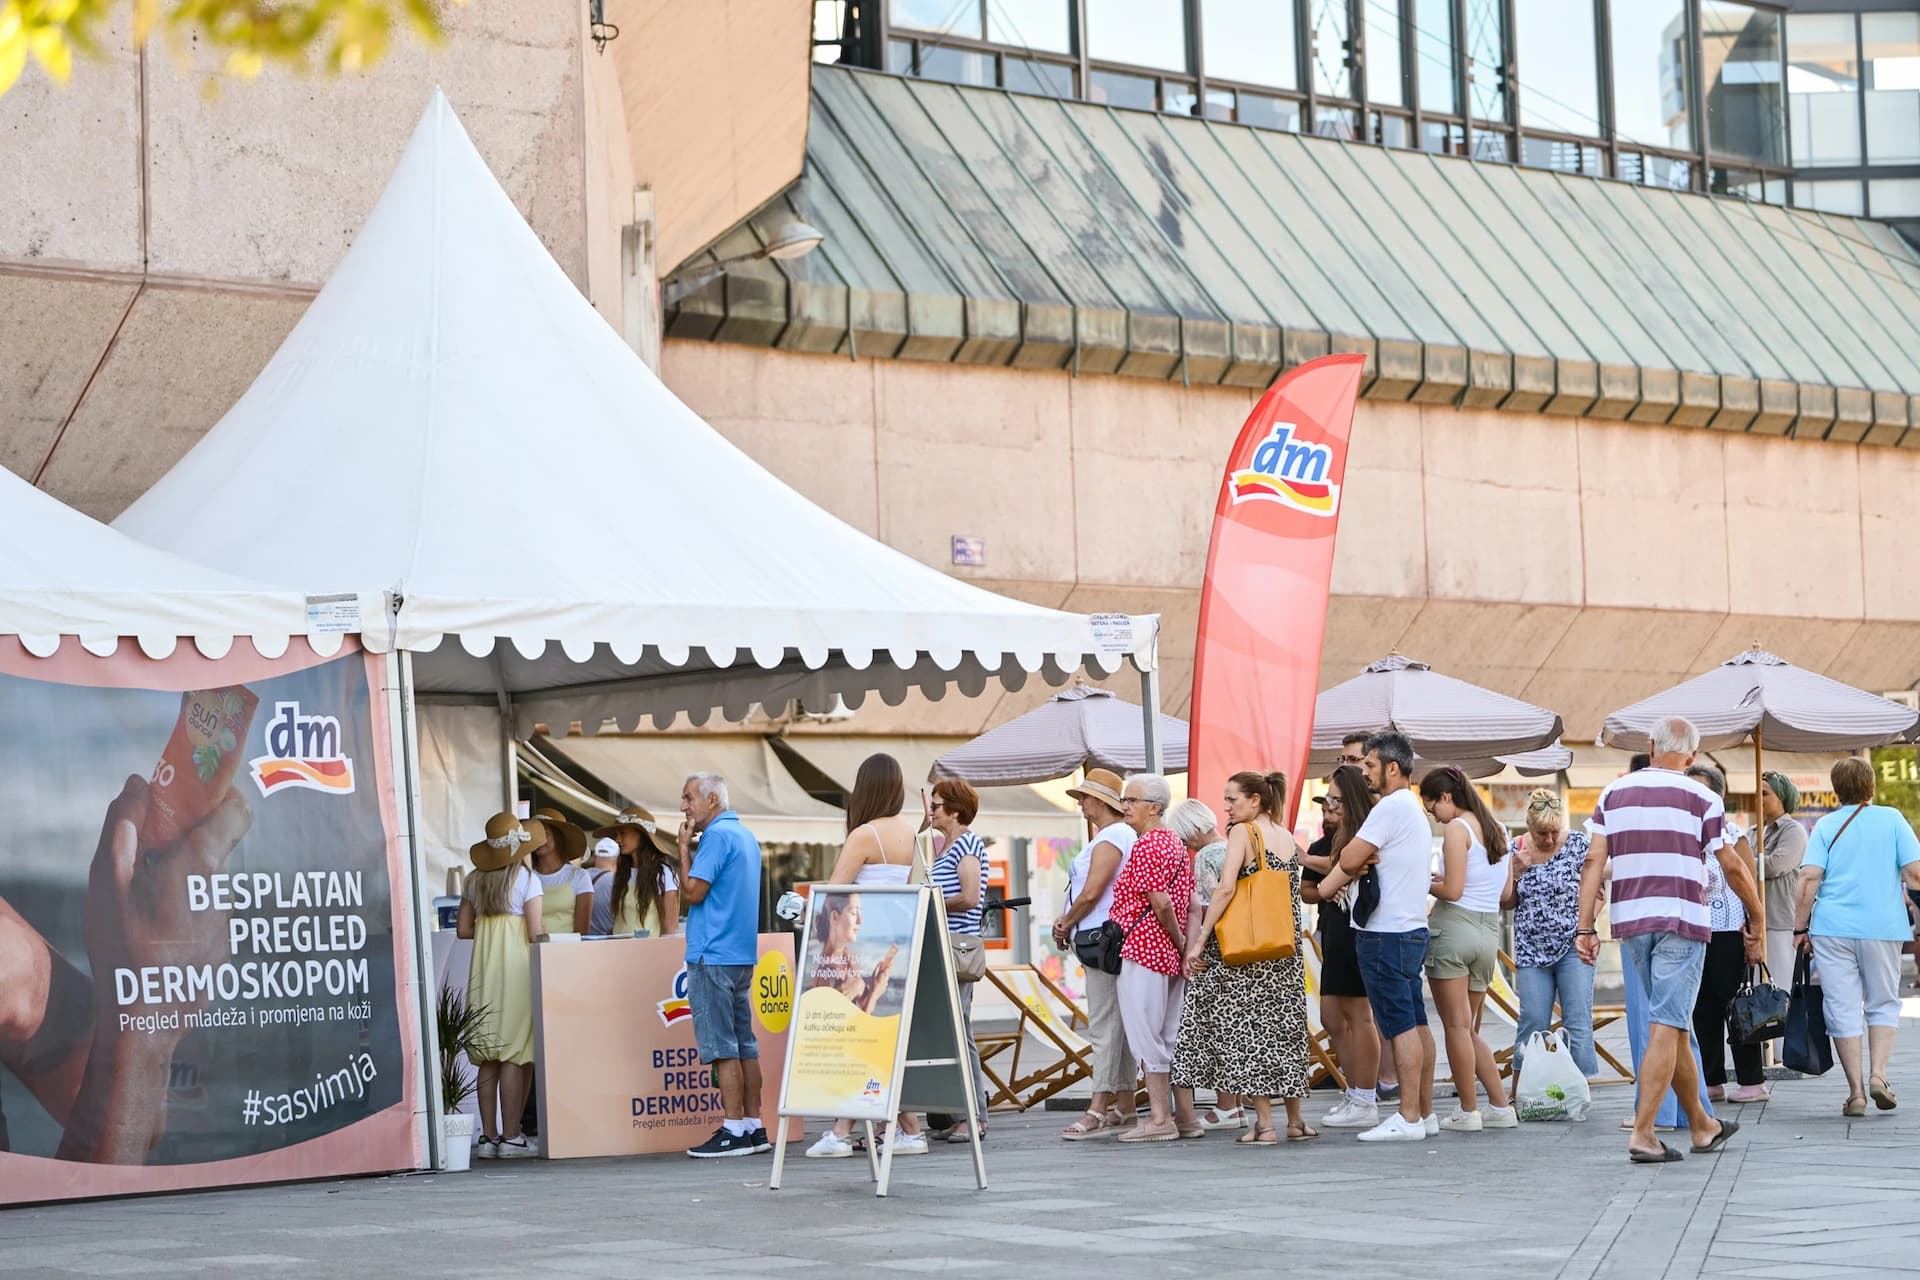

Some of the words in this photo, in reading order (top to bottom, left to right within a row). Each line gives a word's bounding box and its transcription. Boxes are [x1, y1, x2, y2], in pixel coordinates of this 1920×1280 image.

[1253, 427, 1327, 482] dm
[188, 716, 213, 739] dance
[191, 702, 218, 730] sun
[270, 707, 337, 758] dm
[1881, 759, 1920, 781] Eli
[187, 871, 363, 911] BESPLATAN
[229, 915, 367, 955] PREGLED
[115, 958, 369, 1005] DERMOSKOPOM
[759, 974, 789, 998] sun
[119, 1010, 179, 1035] Pregled
[184, 1006, 247, 1028] mladeža
[250, 1007, 256, 1025] i
[260, 1003, 325, 1029] promjena
[329, 1005, 344, 1021] na
[347, 1001, 372, 1019] koži
[760, 1000, 789, 1014] dance
[243, 1053, 377, 1126] #sasvimja
[664, 1070, 710, 1091] PREG
[866, 1078, 880, 1090] dm
[632, 1092, 726, 1116] DERMOSK
[632, 1117, 666, 1130] Pregled
[668, 1114, 701, 1127] mladeža
